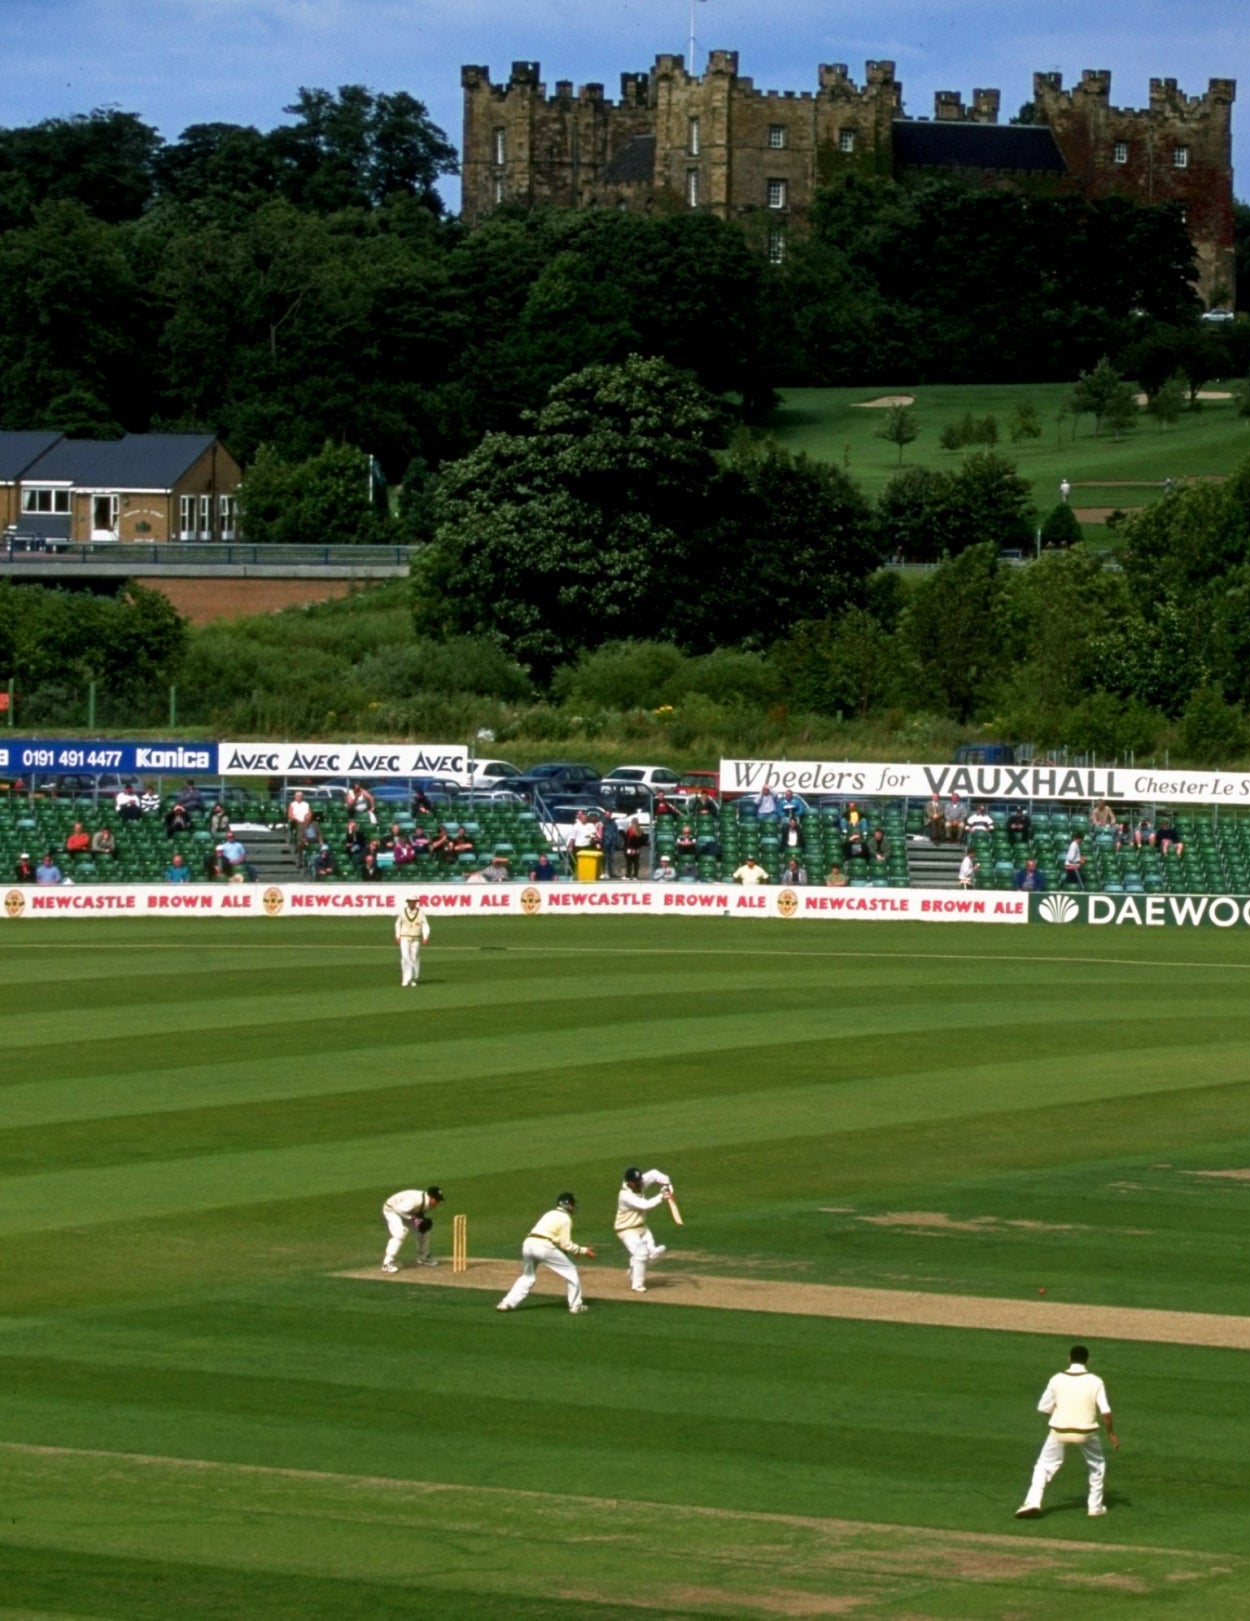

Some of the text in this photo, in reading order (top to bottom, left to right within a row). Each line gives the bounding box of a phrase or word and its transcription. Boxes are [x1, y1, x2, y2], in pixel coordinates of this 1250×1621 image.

[23, 749, 54, 766] 0191
[59, 750, 84, 766] 491
[87, 750, 122, 767] 4477
[136, 747, 209, 768] Konica
[227, 749, 463, 772] AVEC AVEC AVEC AVEC
[734, 762, 1124, 798] Wheelers for VAUXHALL
[1134, 776, 1208, 795] Chester
[1211, 779, 1234, 795] Le
[32, 895, 252, 908] NEWCASTLE BROWN ALE
[291, 894, 510, 907] NEWCASTLE ROWN ALE
[548, 893, 766, 908] NEWCASTLE BROWN ALE
[805, 897, 1023, 914] NEWCASTLE BROWN ALE
